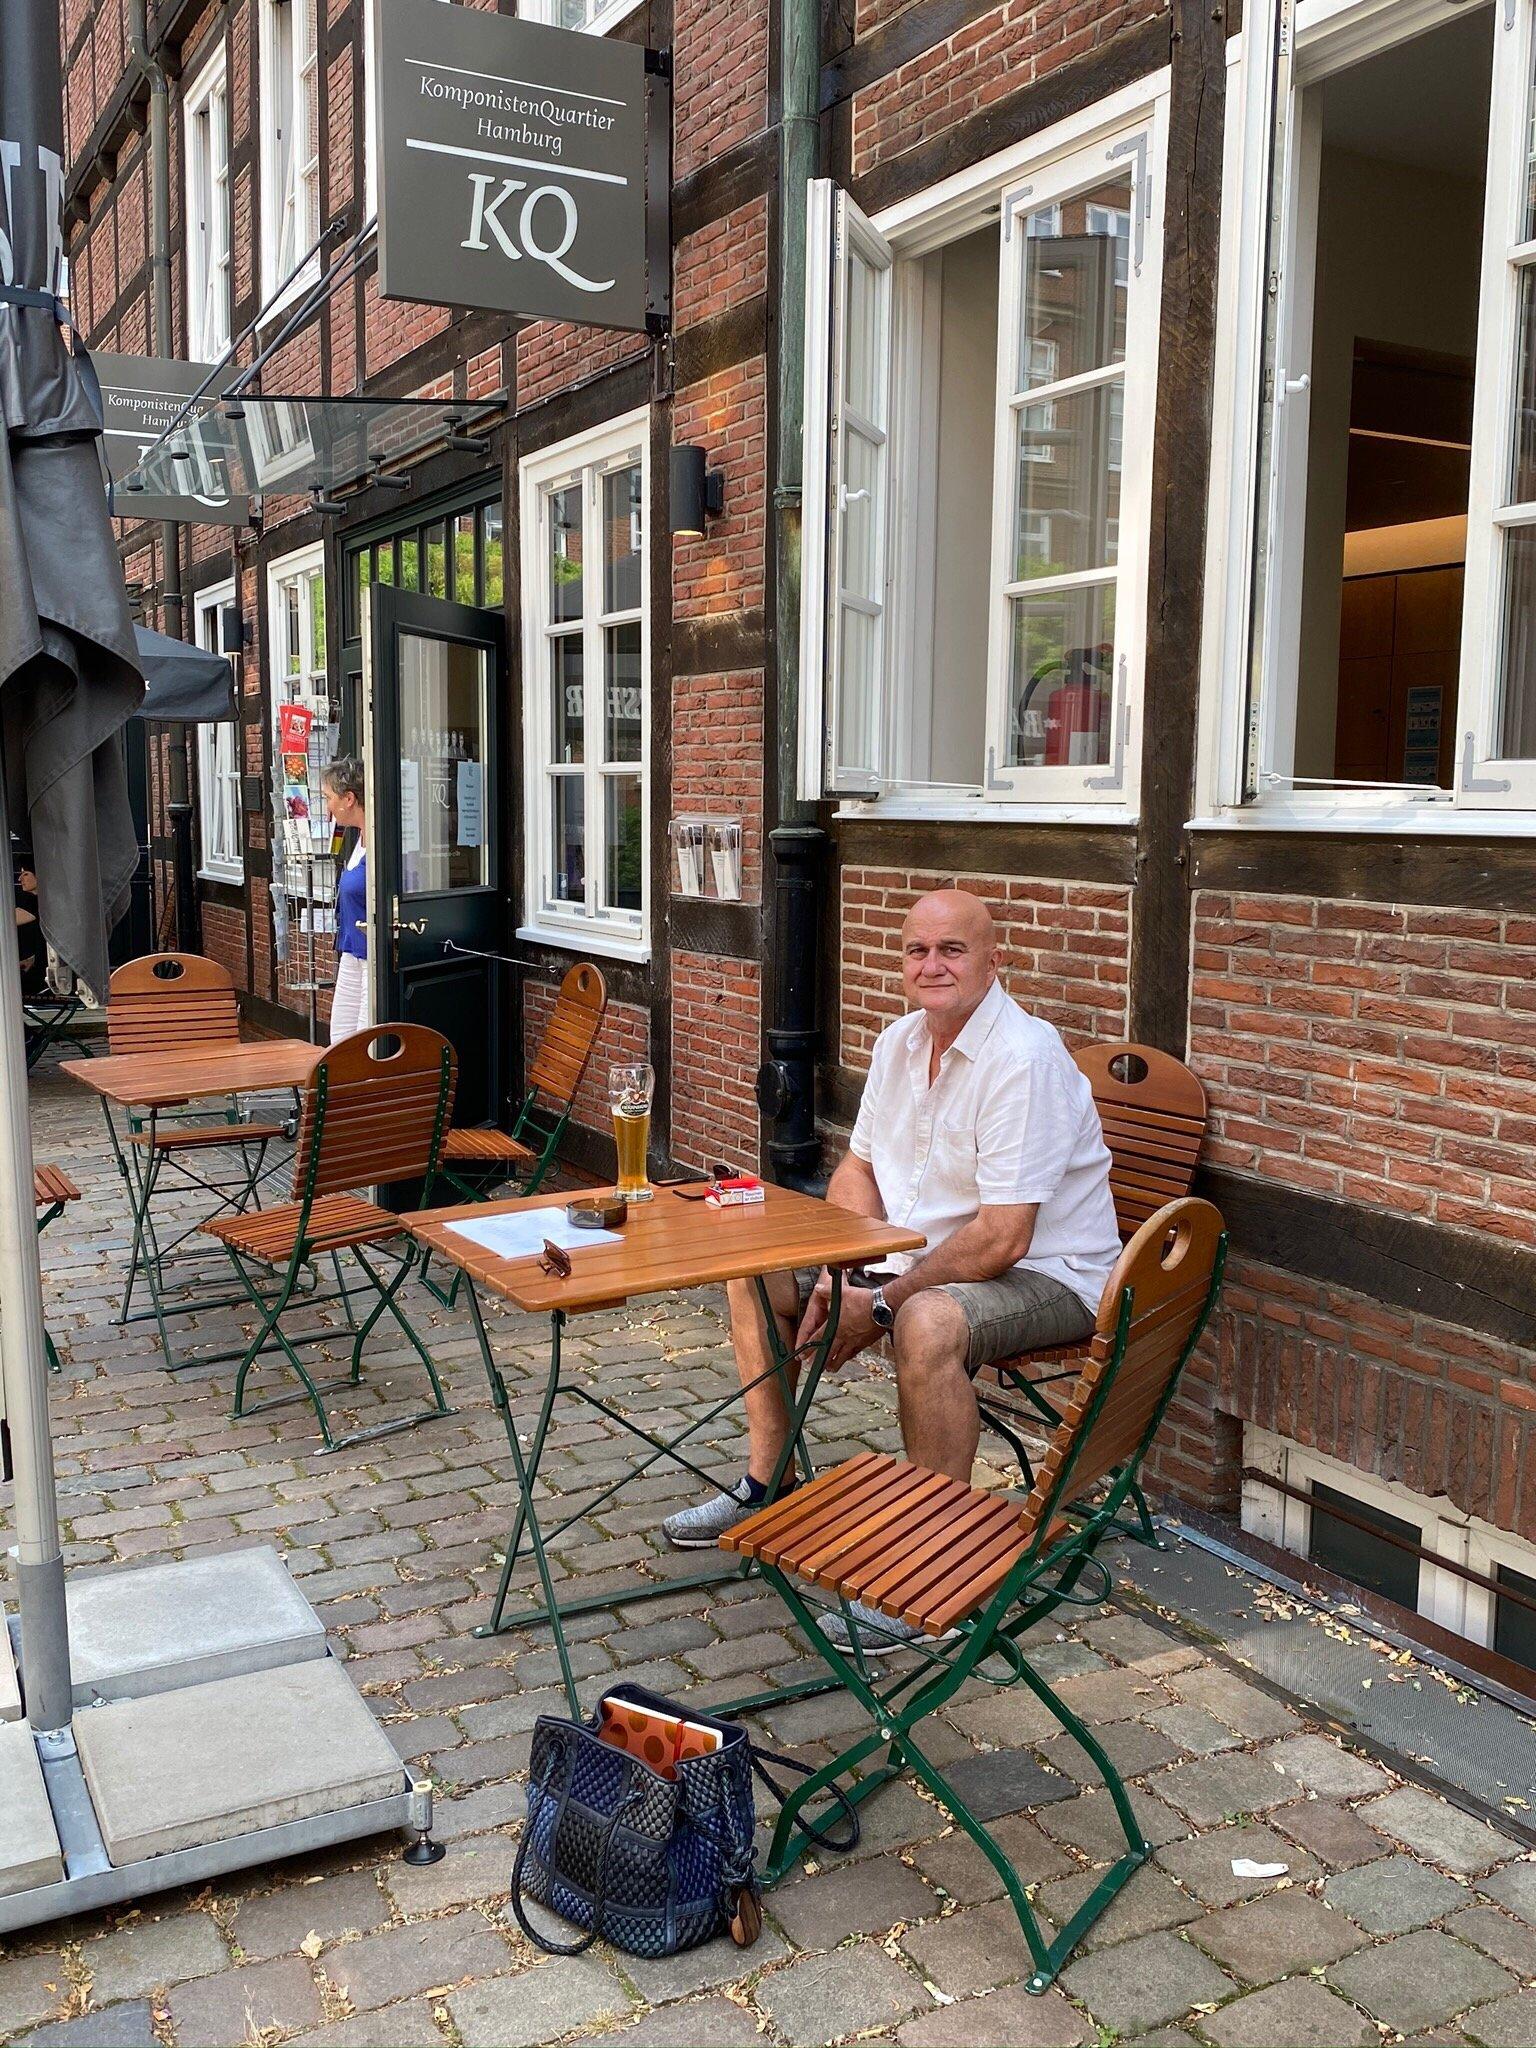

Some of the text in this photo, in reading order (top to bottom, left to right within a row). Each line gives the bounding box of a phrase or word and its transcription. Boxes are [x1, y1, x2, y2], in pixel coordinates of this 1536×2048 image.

[420, 76, 615, 131] KomponistenQuartier
[477, 118, 562, 156] Hamburg
[460, 173, 615, 292] KQ
[431, 783, 450, 809] KQ
